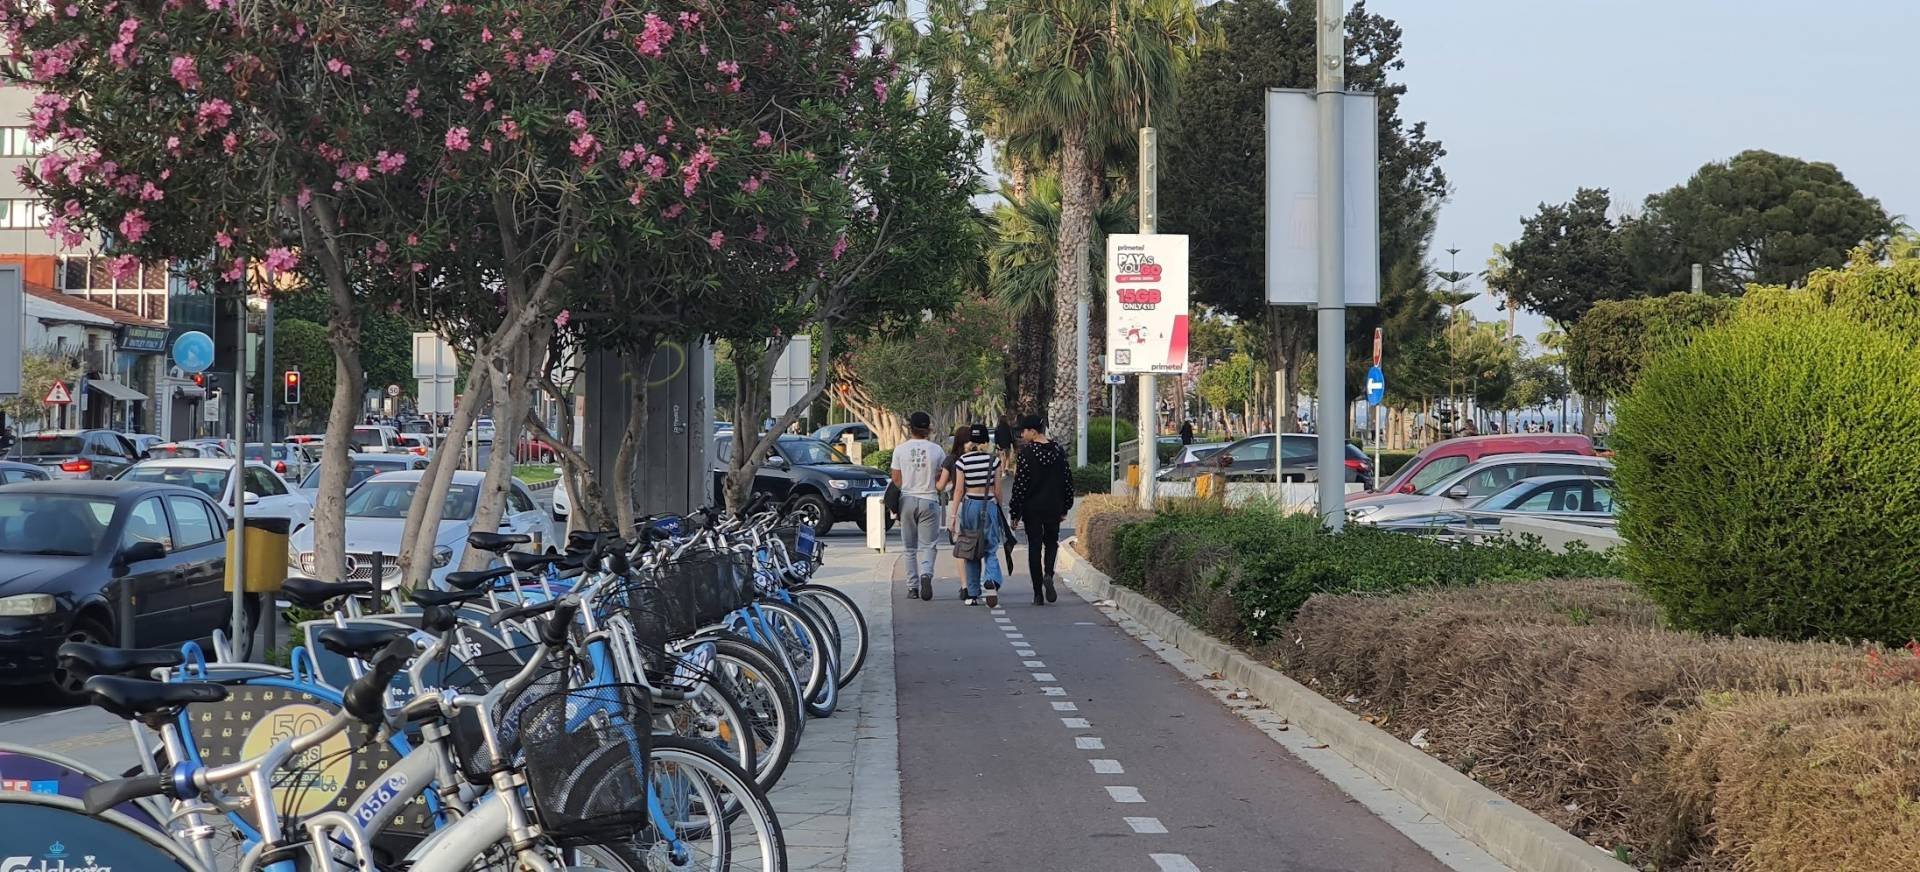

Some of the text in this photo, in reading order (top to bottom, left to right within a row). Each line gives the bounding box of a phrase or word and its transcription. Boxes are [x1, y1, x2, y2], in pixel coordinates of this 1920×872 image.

[1118, 253, 1155, 265] PAY AS
[1119, 264, 1162, 275] YOU GO
[1117, 289, 1162, 304] 15GB
[1151, 362, 1183, 371] primetel
